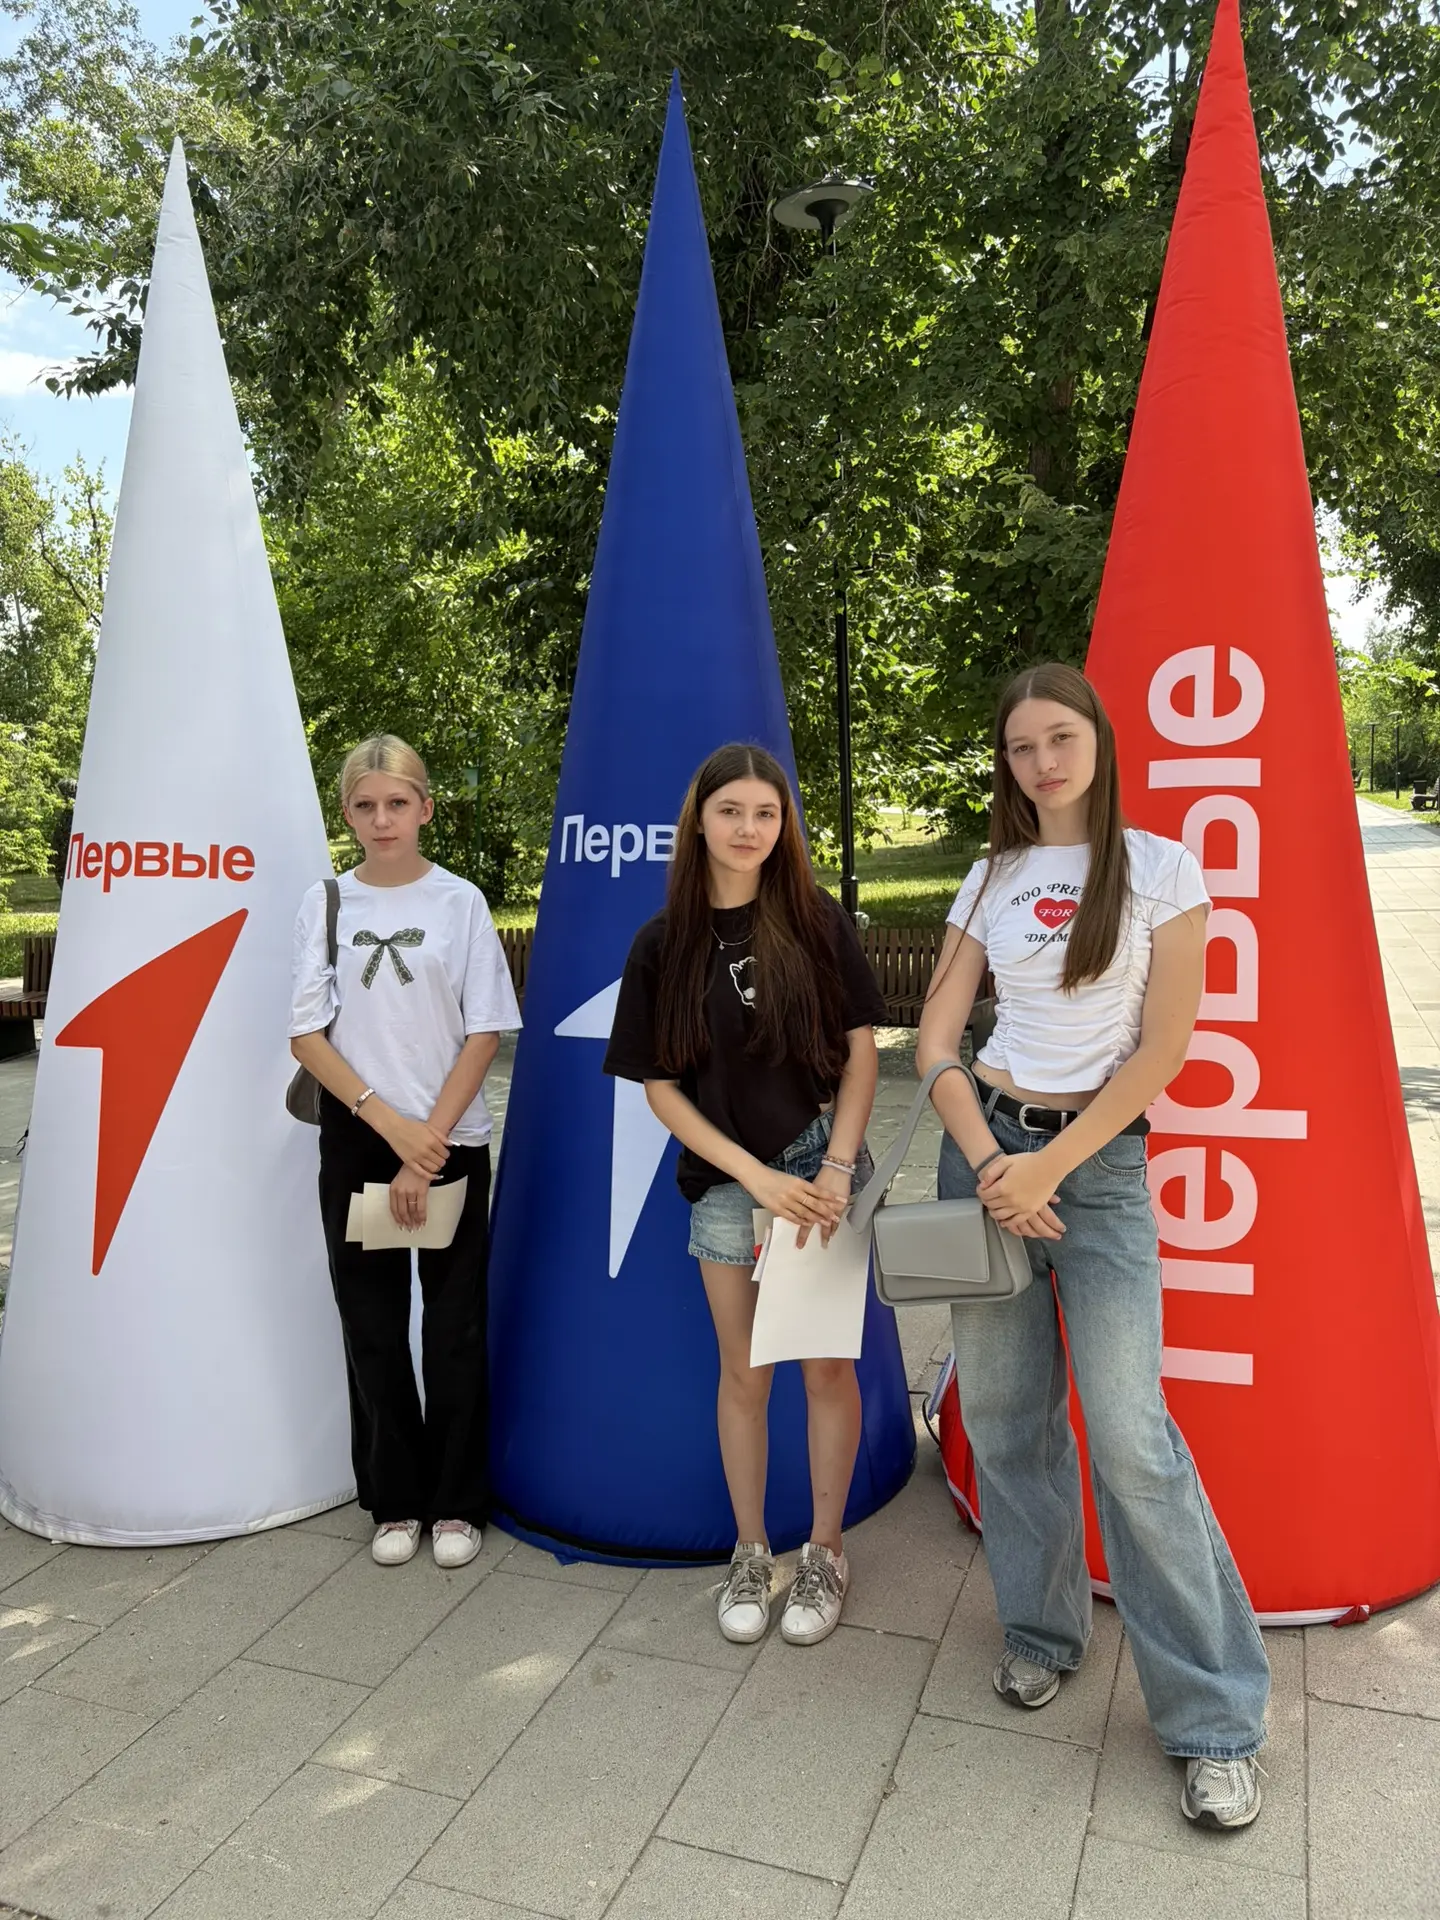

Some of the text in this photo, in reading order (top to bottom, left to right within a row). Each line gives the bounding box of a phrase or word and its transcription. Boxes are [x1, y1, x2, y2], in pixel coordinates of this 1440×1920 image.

[559, 814, 678, 878] Перв
[66, 832, 255, 893] Первые
[1011, 883, 1084, 907] TOO PRE
[1039, 909, 1073, 917] FOR
[1024, 933, 1069, 942] DRAM
